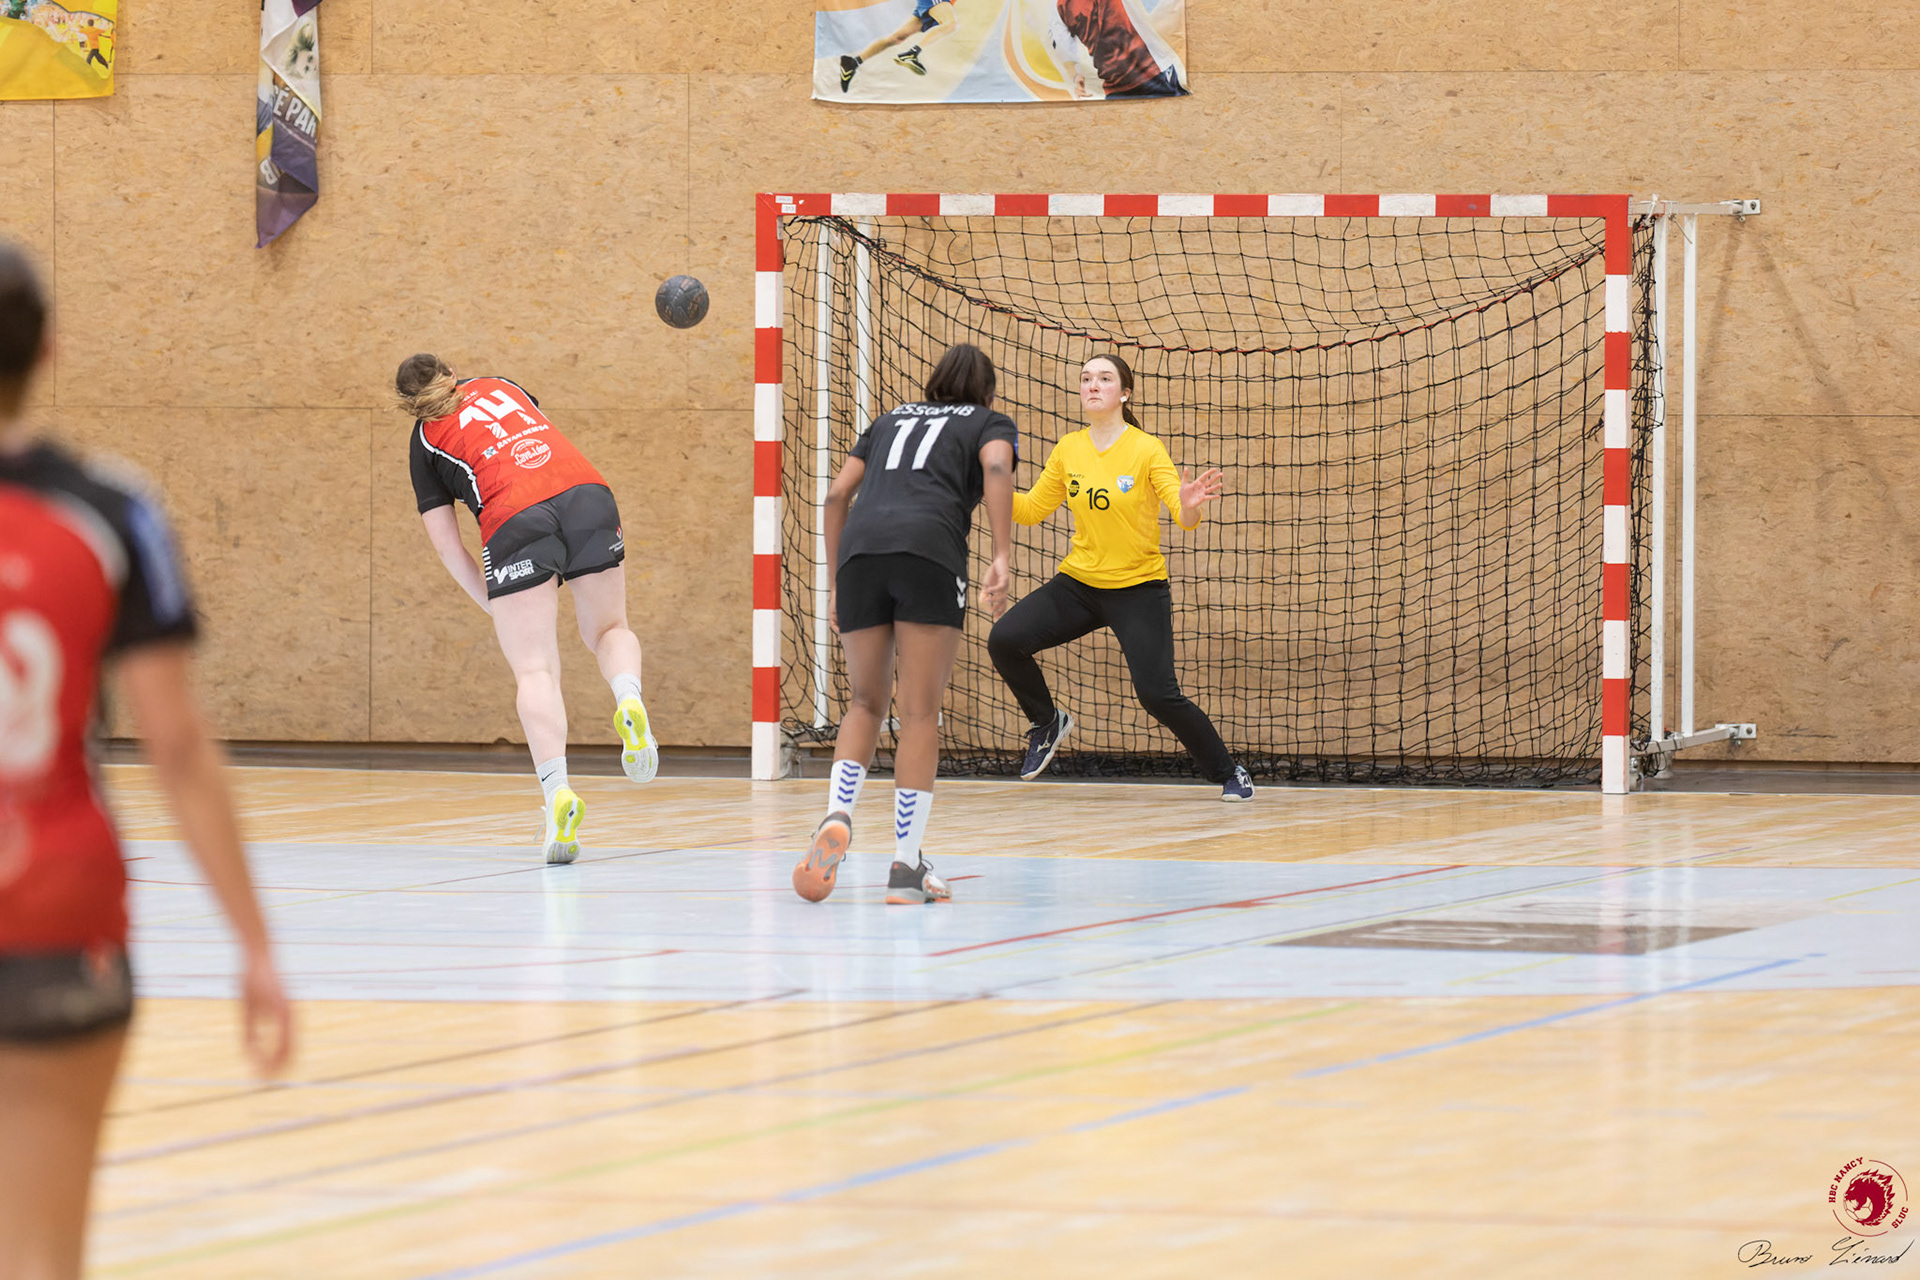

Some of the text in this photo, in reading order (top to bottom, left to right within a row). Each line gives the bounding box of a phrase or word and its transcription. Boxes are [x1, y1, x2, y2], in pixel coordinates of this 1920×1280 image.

[885, 416, 949, 470] 11
[1086, 487, 1110, 511] 16
[508, 559, 533, 572] INTER
[509, 567, 535, 581] SPORT
